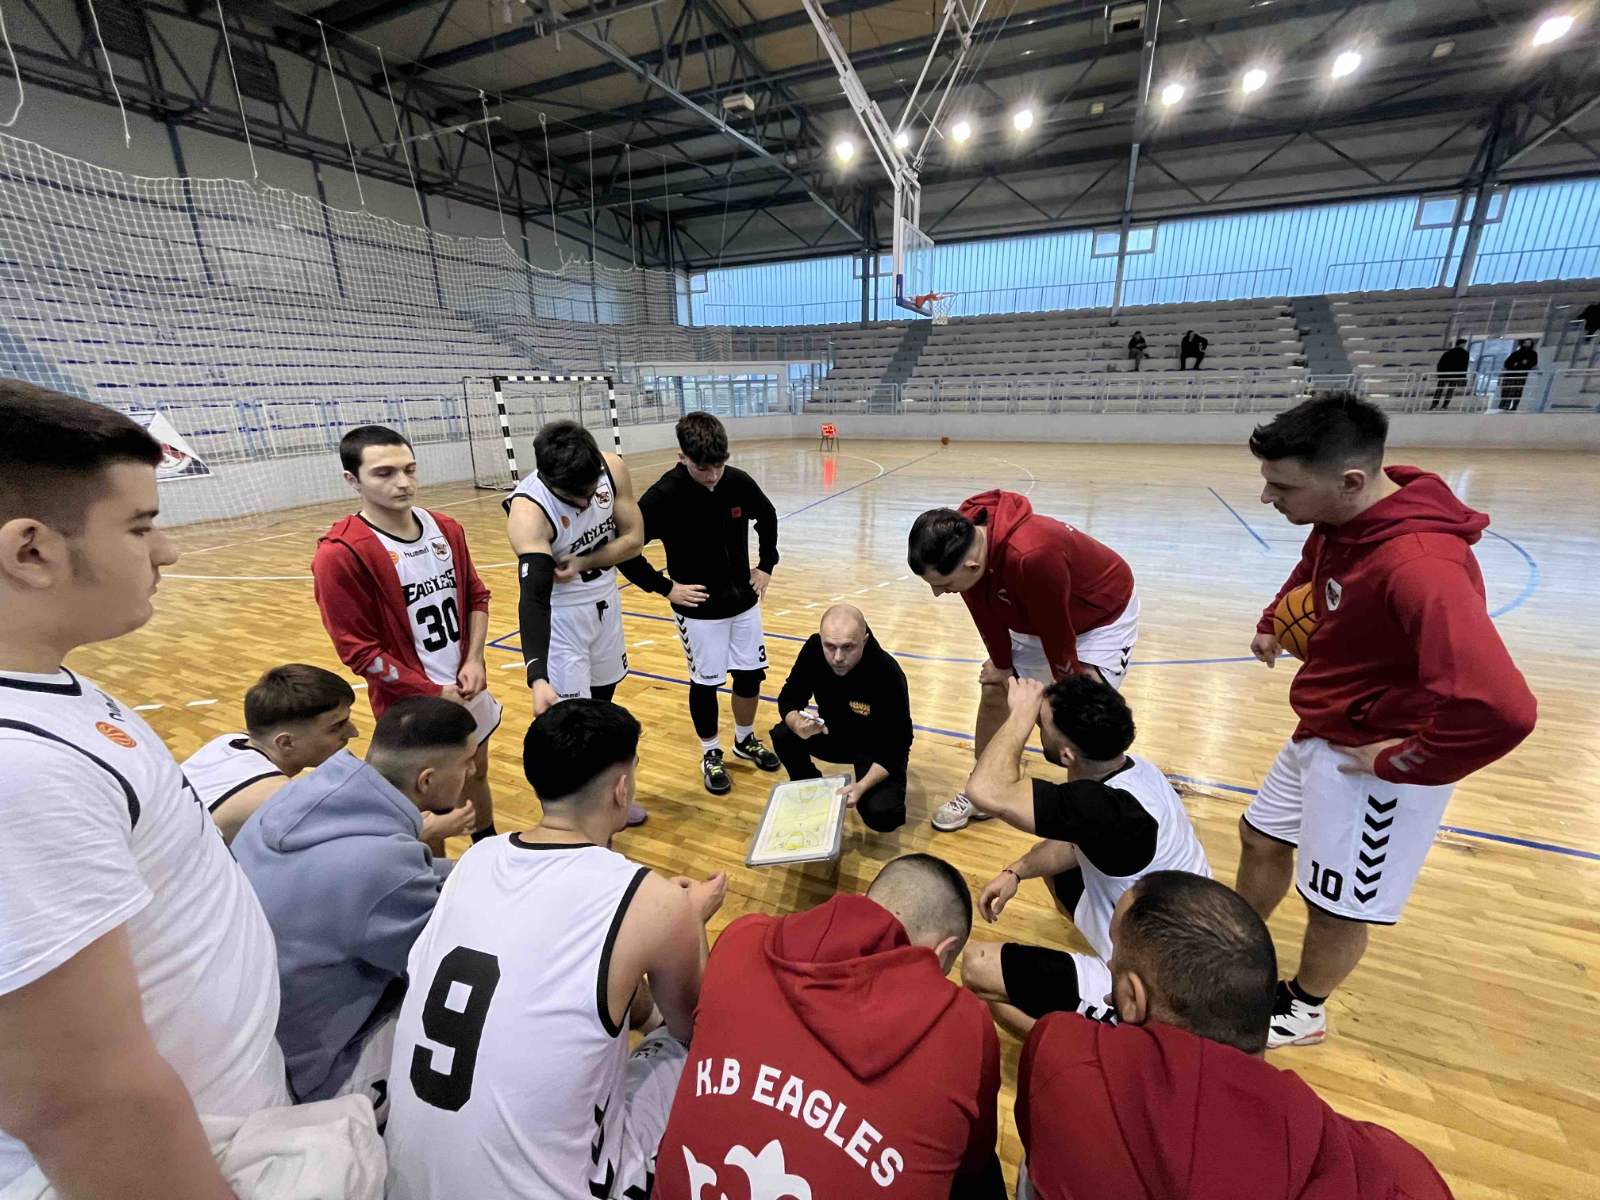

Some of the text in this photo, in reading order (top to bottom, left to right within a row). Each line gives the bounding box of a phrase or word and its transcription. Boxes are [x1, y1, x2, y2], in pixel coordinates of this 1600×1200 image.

[401, 568, 457, 607] EAGLES
[416, 597, 461, 653] 30
[758, 644, 767, 663] 3
[1308, 859, 1344, 902] 10
[409, 945, 501, 1112] 9
[696, 1057, 904, 1188] K.B EAGLES
